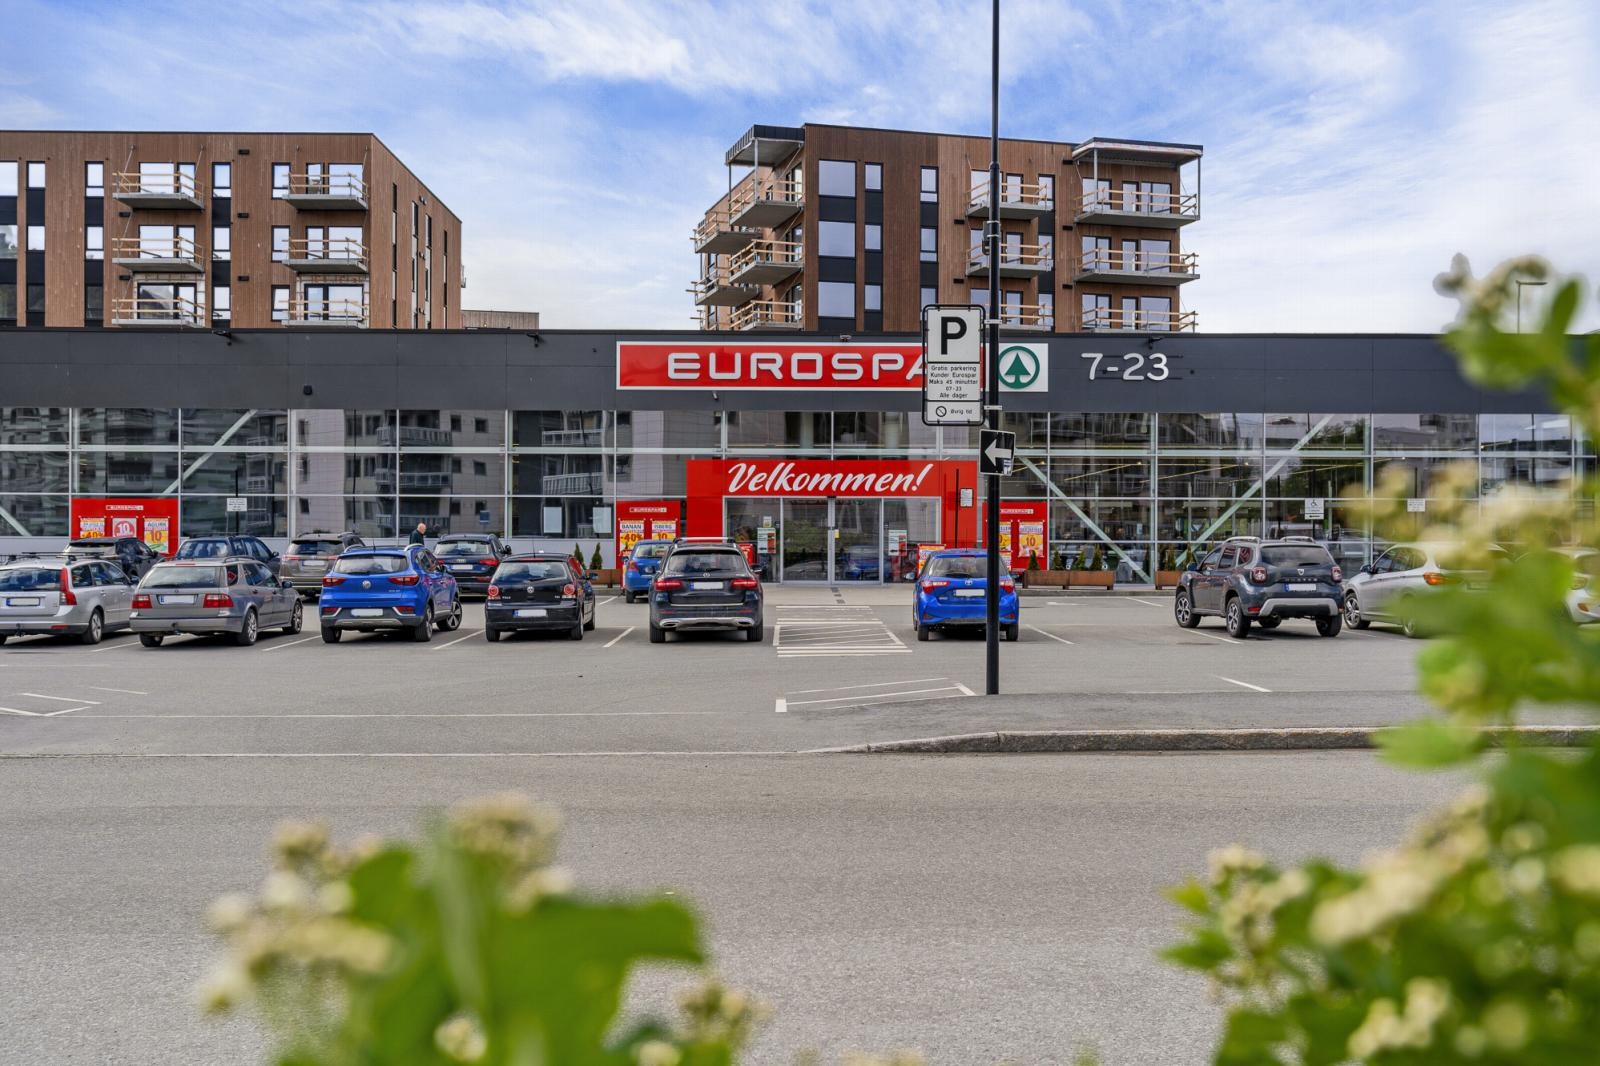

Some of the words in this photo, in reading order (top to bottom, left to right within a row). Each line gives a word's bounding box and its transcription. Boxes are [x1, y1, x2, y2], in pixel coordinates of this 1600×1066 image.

[941, 316, 967, 355] P
[667, 352, 928, 380] EUROSPA
[950, 365, 977, 373] parkering
[1081, 353, 1169, 381] 7-23
[728, 462, 934, 493] Velkommen!
